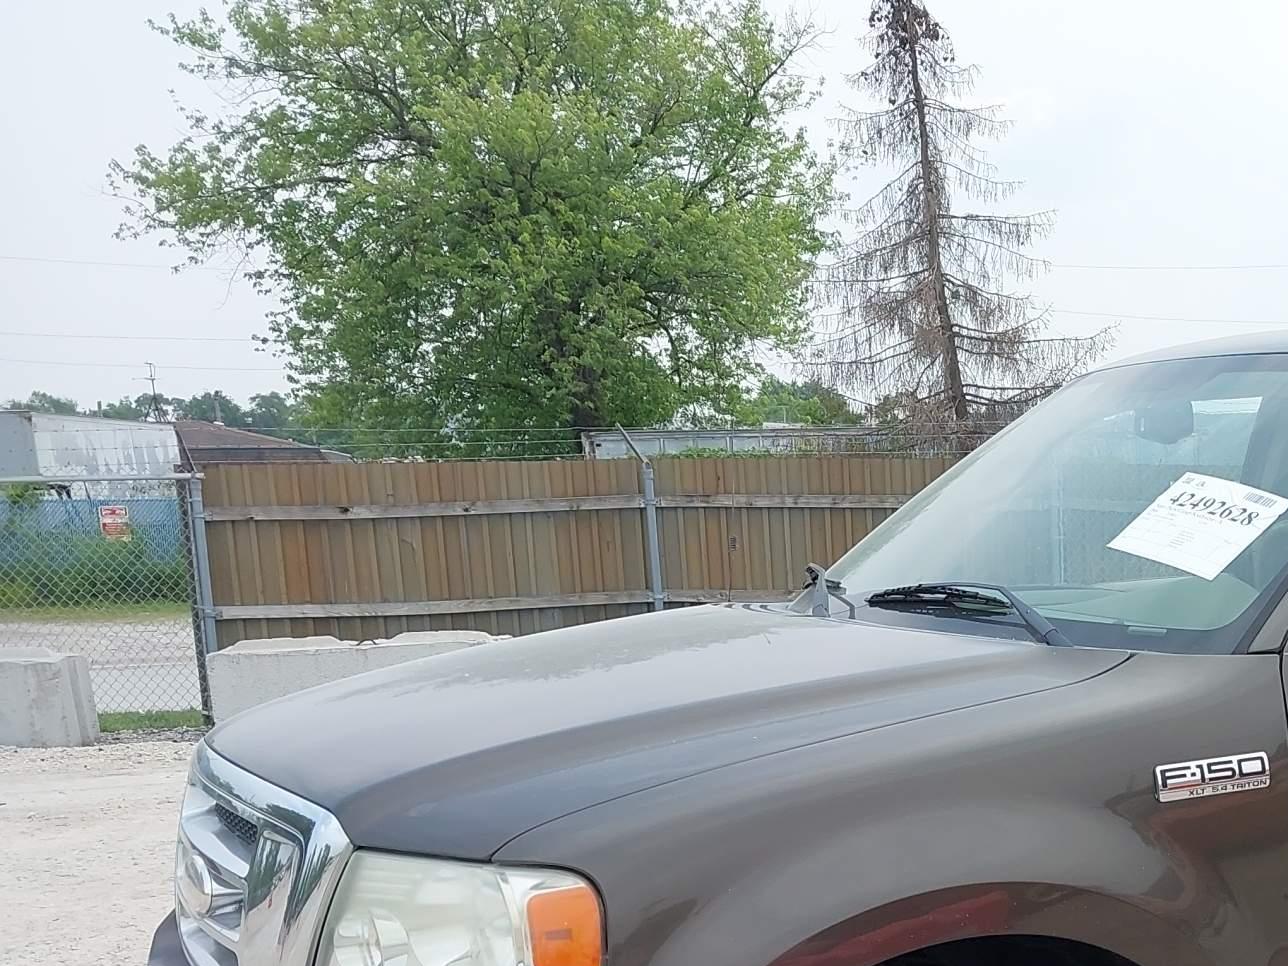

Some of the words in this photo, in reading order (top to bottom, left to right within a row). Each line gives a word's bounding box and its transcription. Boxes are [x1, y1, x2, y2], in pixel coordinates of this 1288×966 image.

[1170, 491, 1261, 527] 42492628
[1159, 756, 1268, 789] F-150
[1188, 787, 1206, 797] XLT
[1211, 784, 1228, 794] 5.4
[1231, 779, 1268, 791] TRITON
